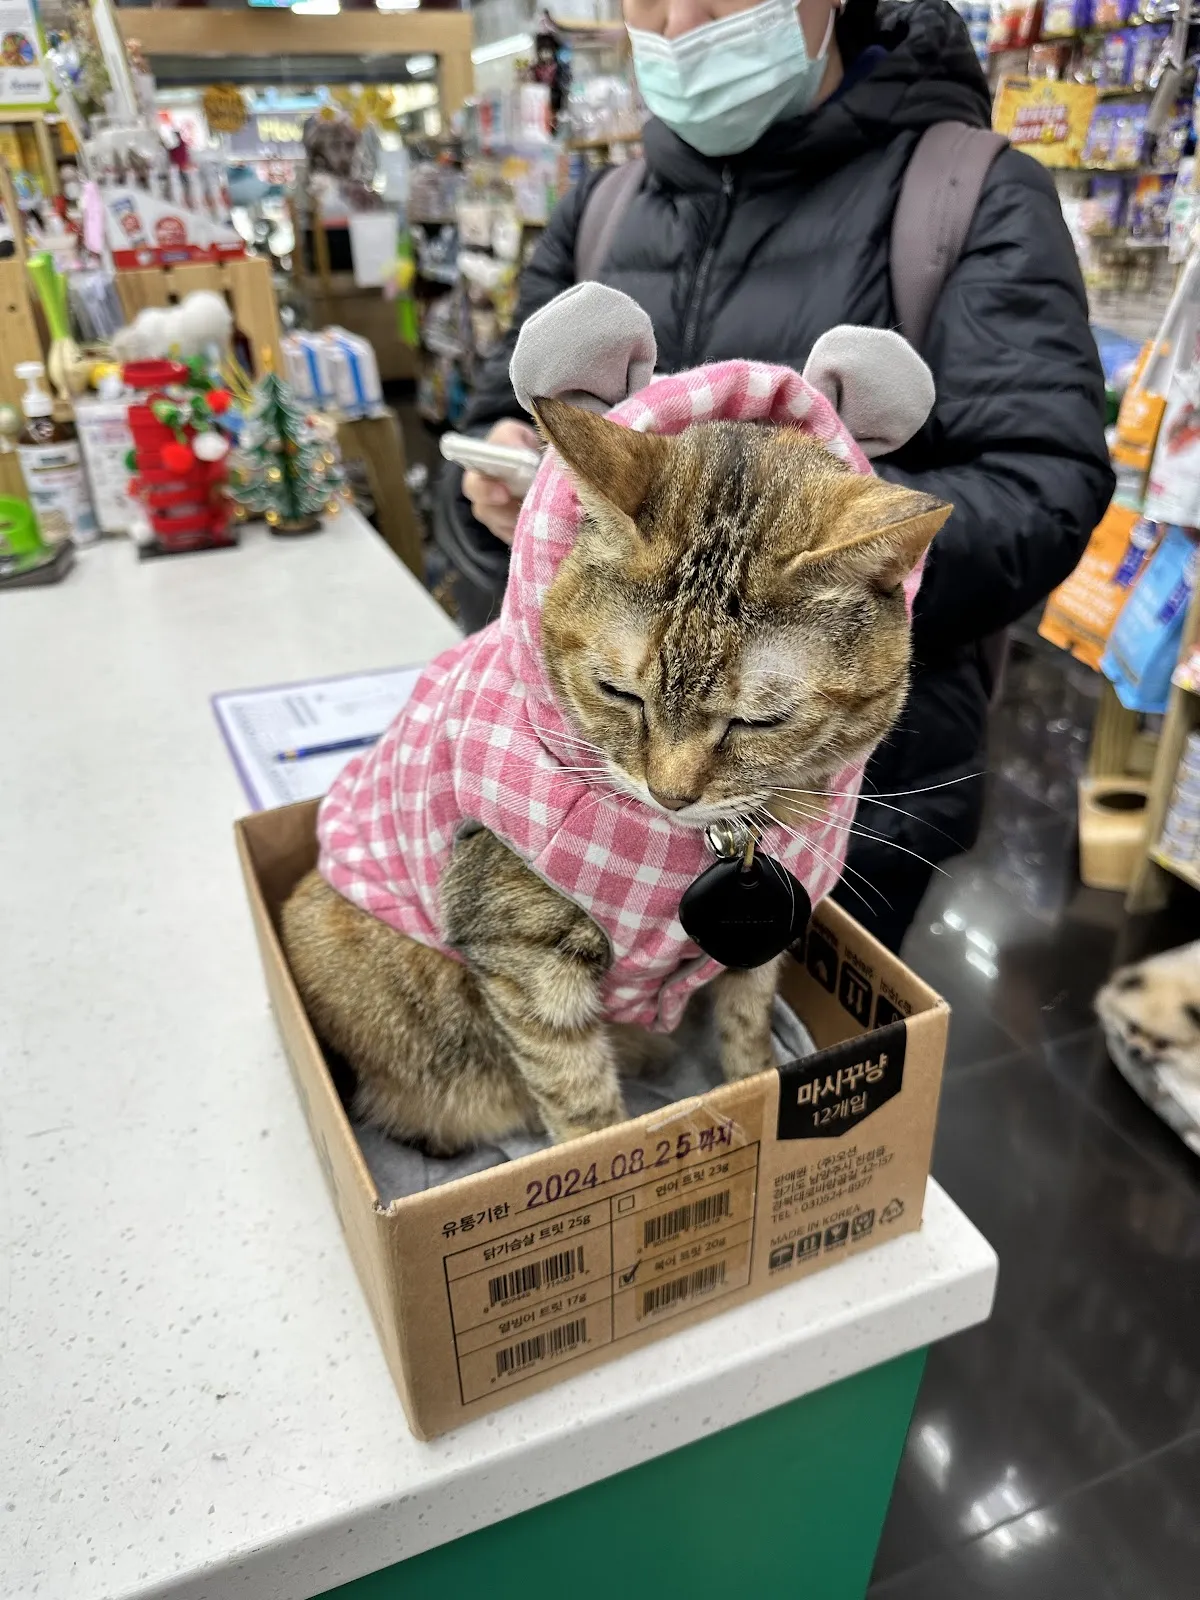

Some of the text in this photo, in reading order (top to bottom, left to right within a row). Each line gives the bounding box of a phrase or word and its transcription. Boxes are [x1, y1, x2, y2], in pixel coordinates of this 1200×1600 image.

[797, 1053, 887, 1105] 마시꾸냥
[812, 1091, 868, 1127] 12개입
[708, 1163, 729, 1177] 23g
[773, 1178, 805, 1199] 경기도
[442, 1202, 511, 1239] 유통기한
[770, 1226, 805, 1247] MADE
[807, 1219, 819, 1231] IN
[822, 1204, 861, 1226] KOREA
[771, 1210, 791, 1223] TEL
[483, 1215, 592, 1261] 닭가슴살 트릿 25g
[539, 1301, 563, 1317] 트릿
[567, 1293, 588, 1307] 17g
